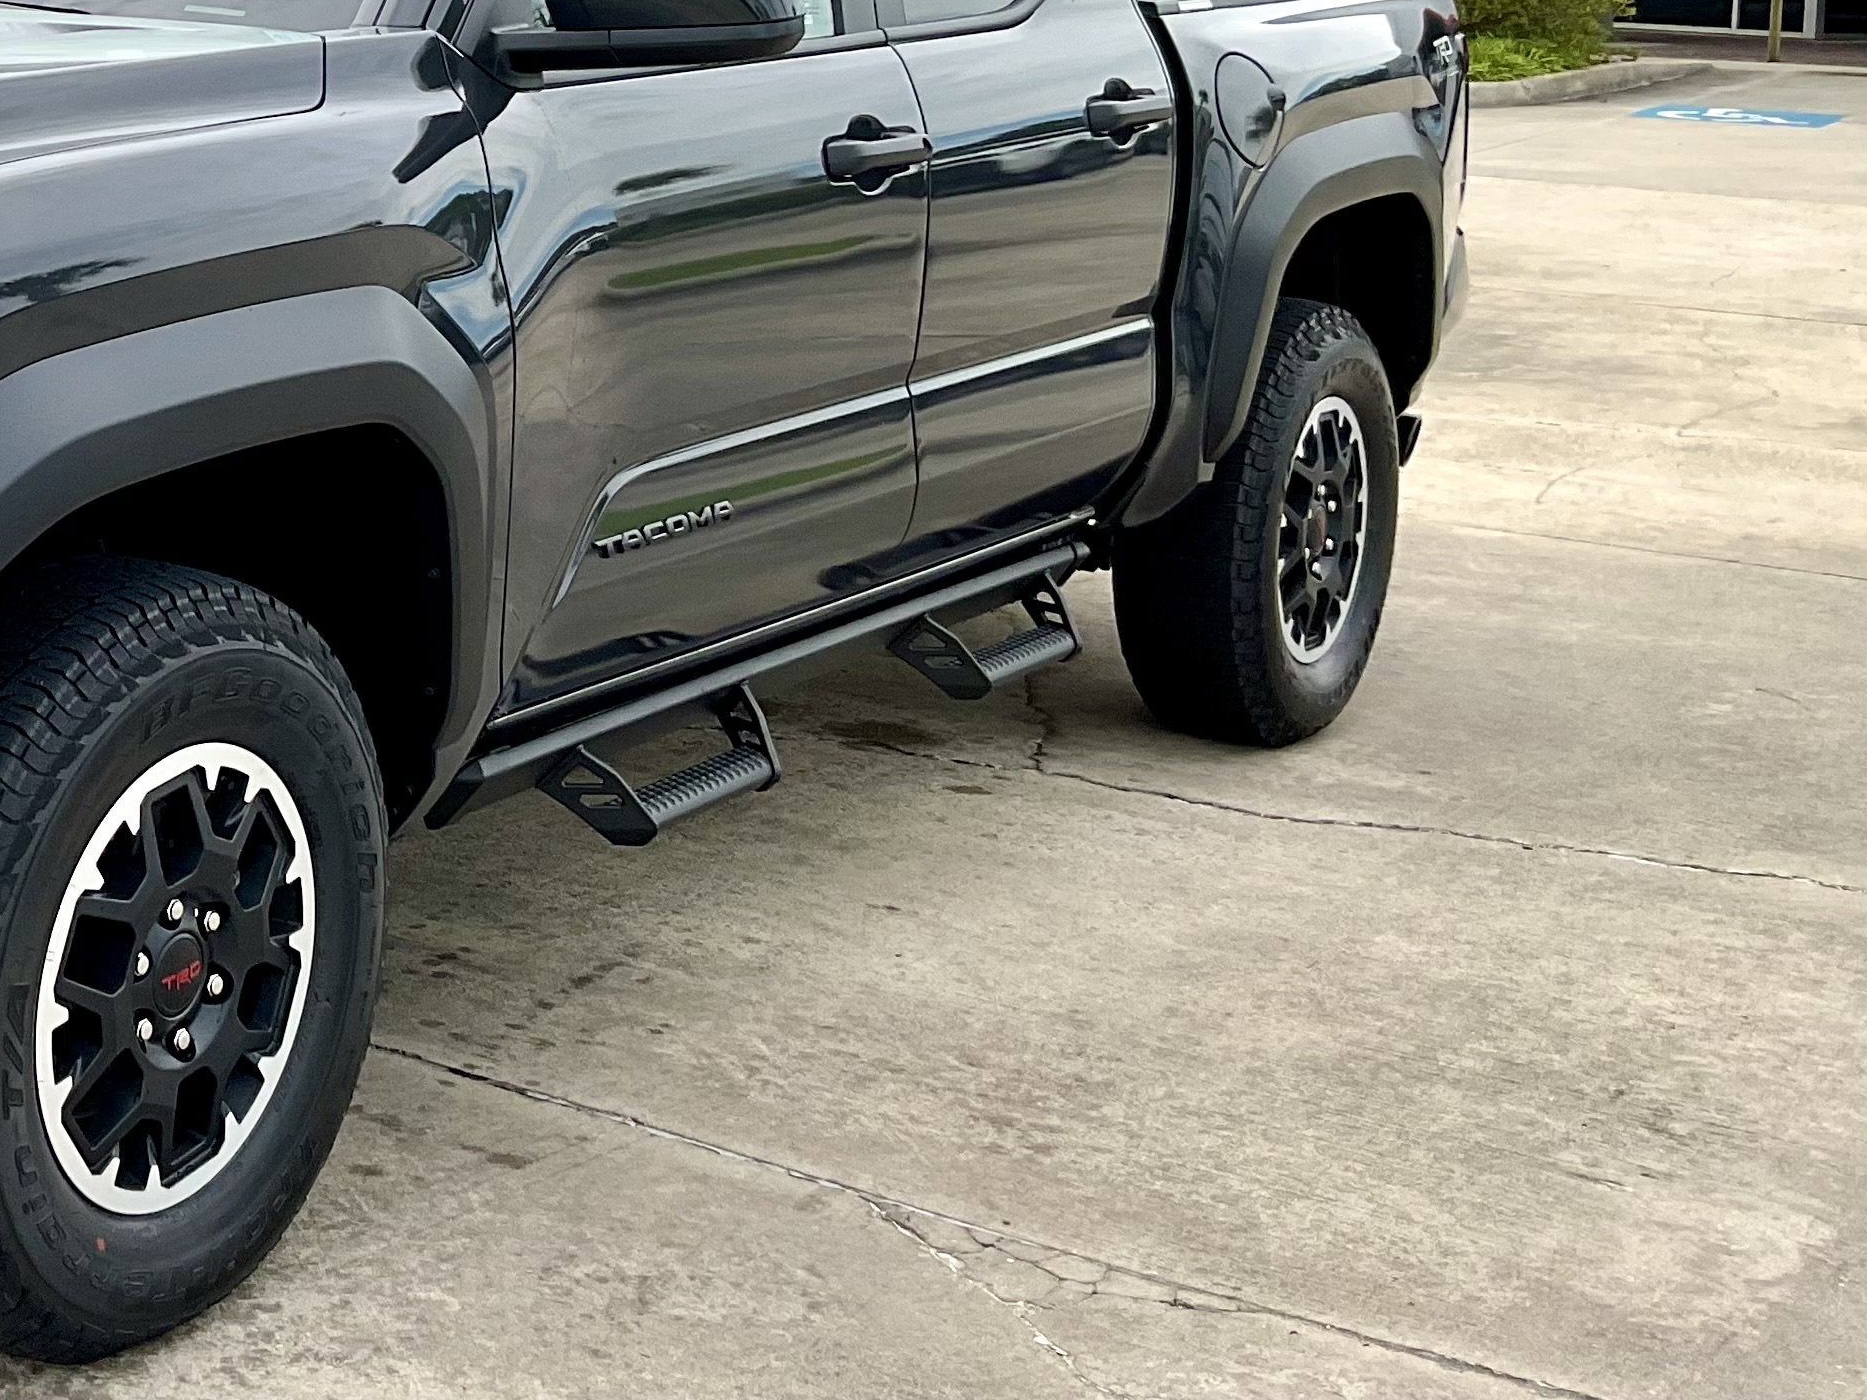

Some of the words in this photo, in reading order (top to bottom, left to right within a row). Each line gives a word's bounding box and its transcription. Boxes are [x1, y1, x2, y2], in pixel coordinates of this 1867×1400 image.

[592, 500, 734, 557] TACOMA
[139, 666, 379, 893] BFGoodrich
[160, 960, 202, 991] TRD
